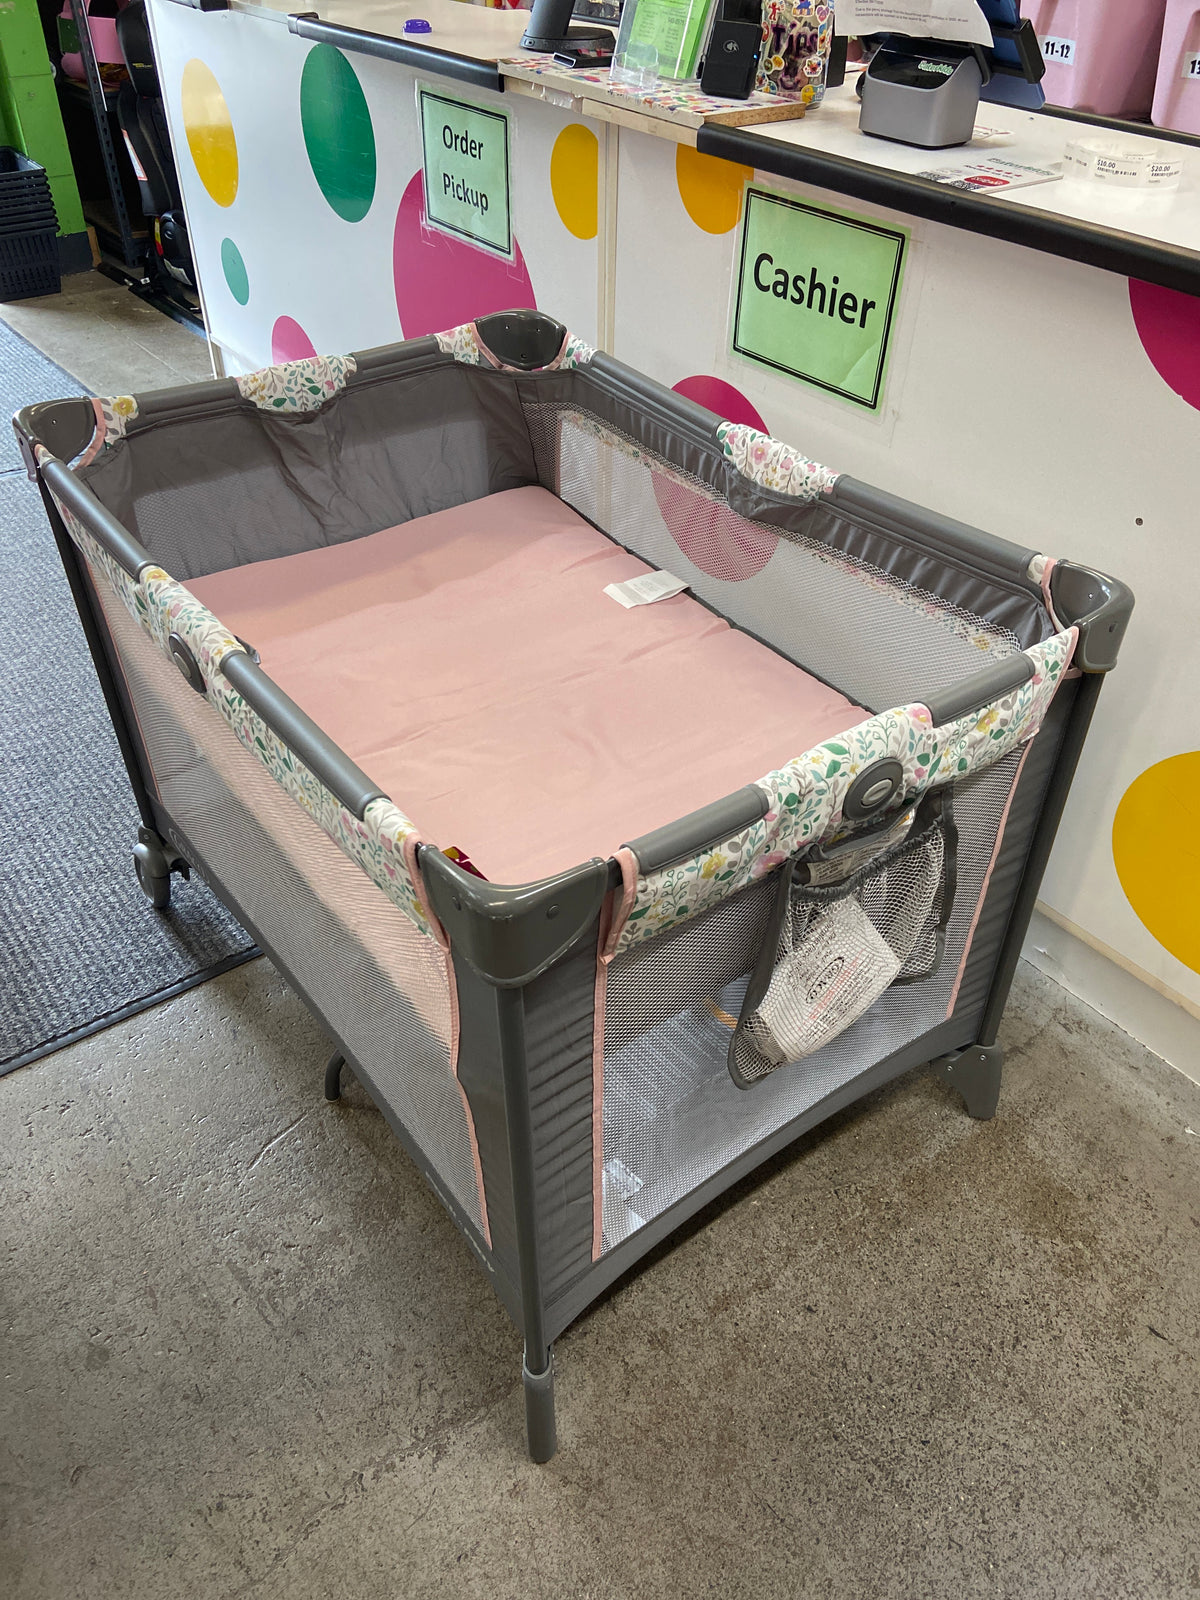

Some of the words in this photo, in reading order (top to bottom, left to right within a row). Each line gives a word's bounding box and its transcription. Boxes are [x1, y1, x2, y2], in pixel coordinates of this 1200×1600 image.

[1044, 41, 1071, 58] 11-12
[442, 124, 484, 160] Order
[1097, 159, 1116, 169] $10.00
[1151, 165, 1171, 173] $20.00
[442, 172, 489, 215] Pickup
[753, 252, 876, 329] Cashier
